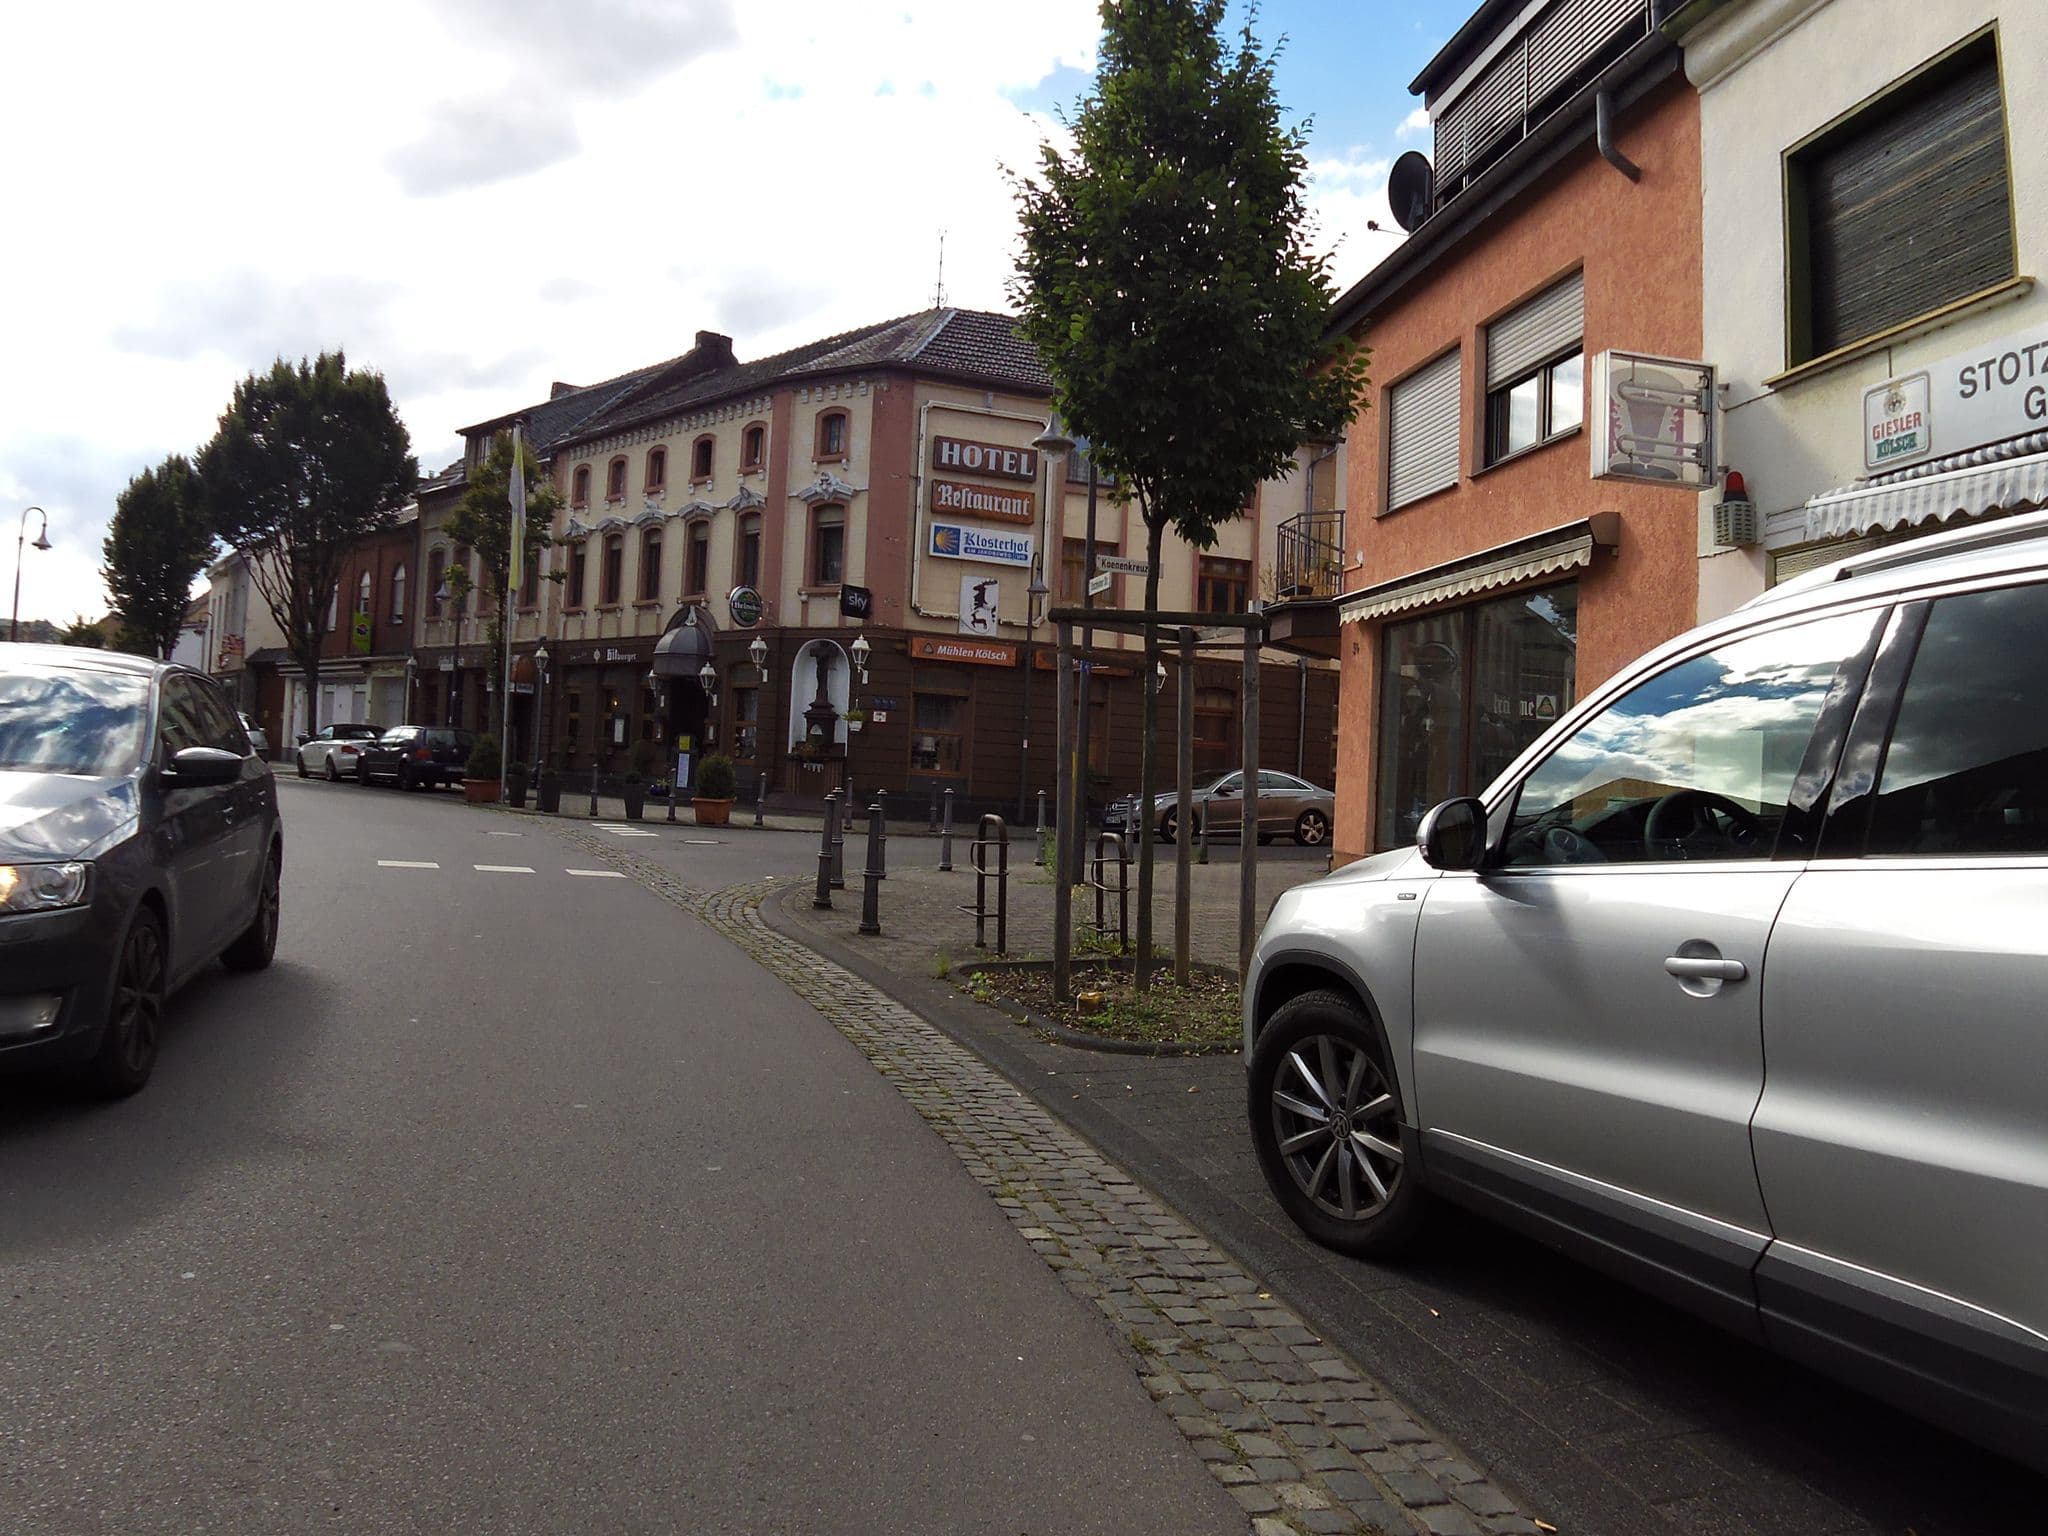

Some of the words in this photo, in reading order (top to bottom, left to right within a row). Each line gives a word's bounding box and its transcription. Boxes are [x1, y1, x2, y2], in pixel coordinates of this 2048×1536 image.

[1872, 411, 1922, 441] GIESLER
[941, 441, 1034, 476] HOTEL
[937, 484, 1030, 516] Restaurant
[963, 531, 1029, 554] Klosterhof
[1101, 558, 1149, 574] Koenenkreuz
[849, 593, 868, 611] sky
[937, 645, 974, 658] Mühlen
[974, 648, 1008, 661] Kölsch
